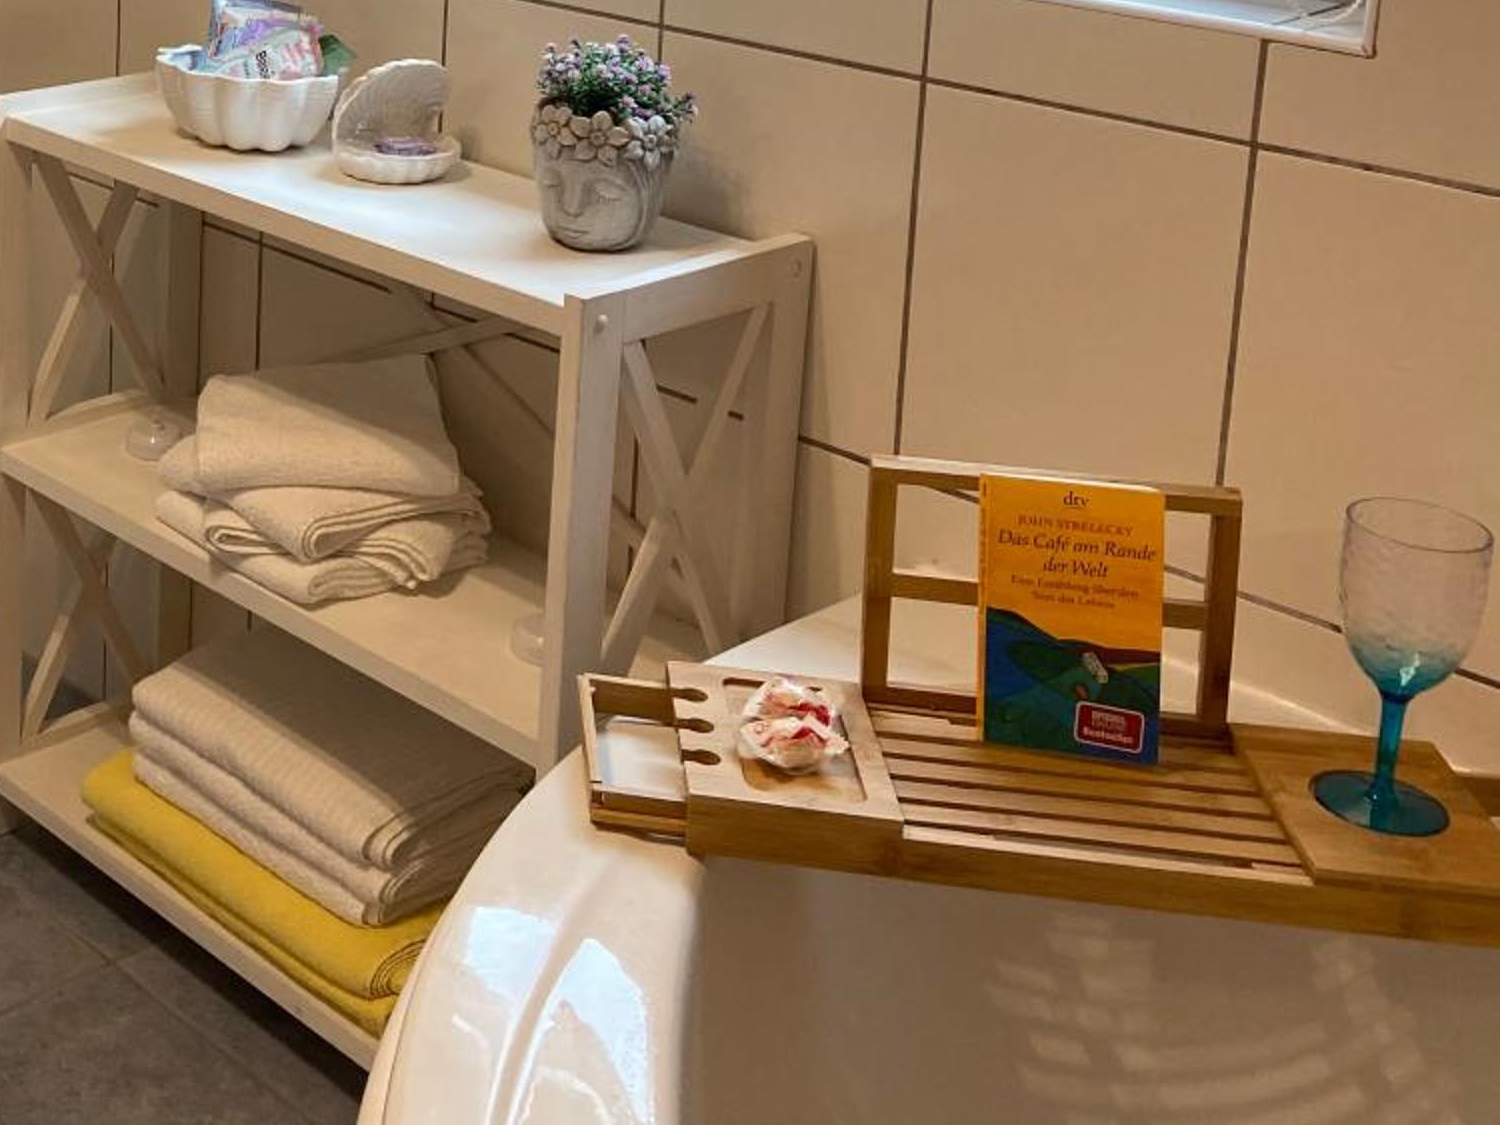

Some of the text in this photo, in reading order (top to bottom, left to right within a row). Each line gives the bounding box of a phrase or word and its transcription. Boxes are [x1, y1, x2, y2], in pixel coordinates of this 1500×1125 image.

[997, 528, 1029, 546] Das
[1073, 542, 1100, 554] am
[1104, 540, 1157, 561] Rande
[1043, 556, 1109, 578] der Welt
